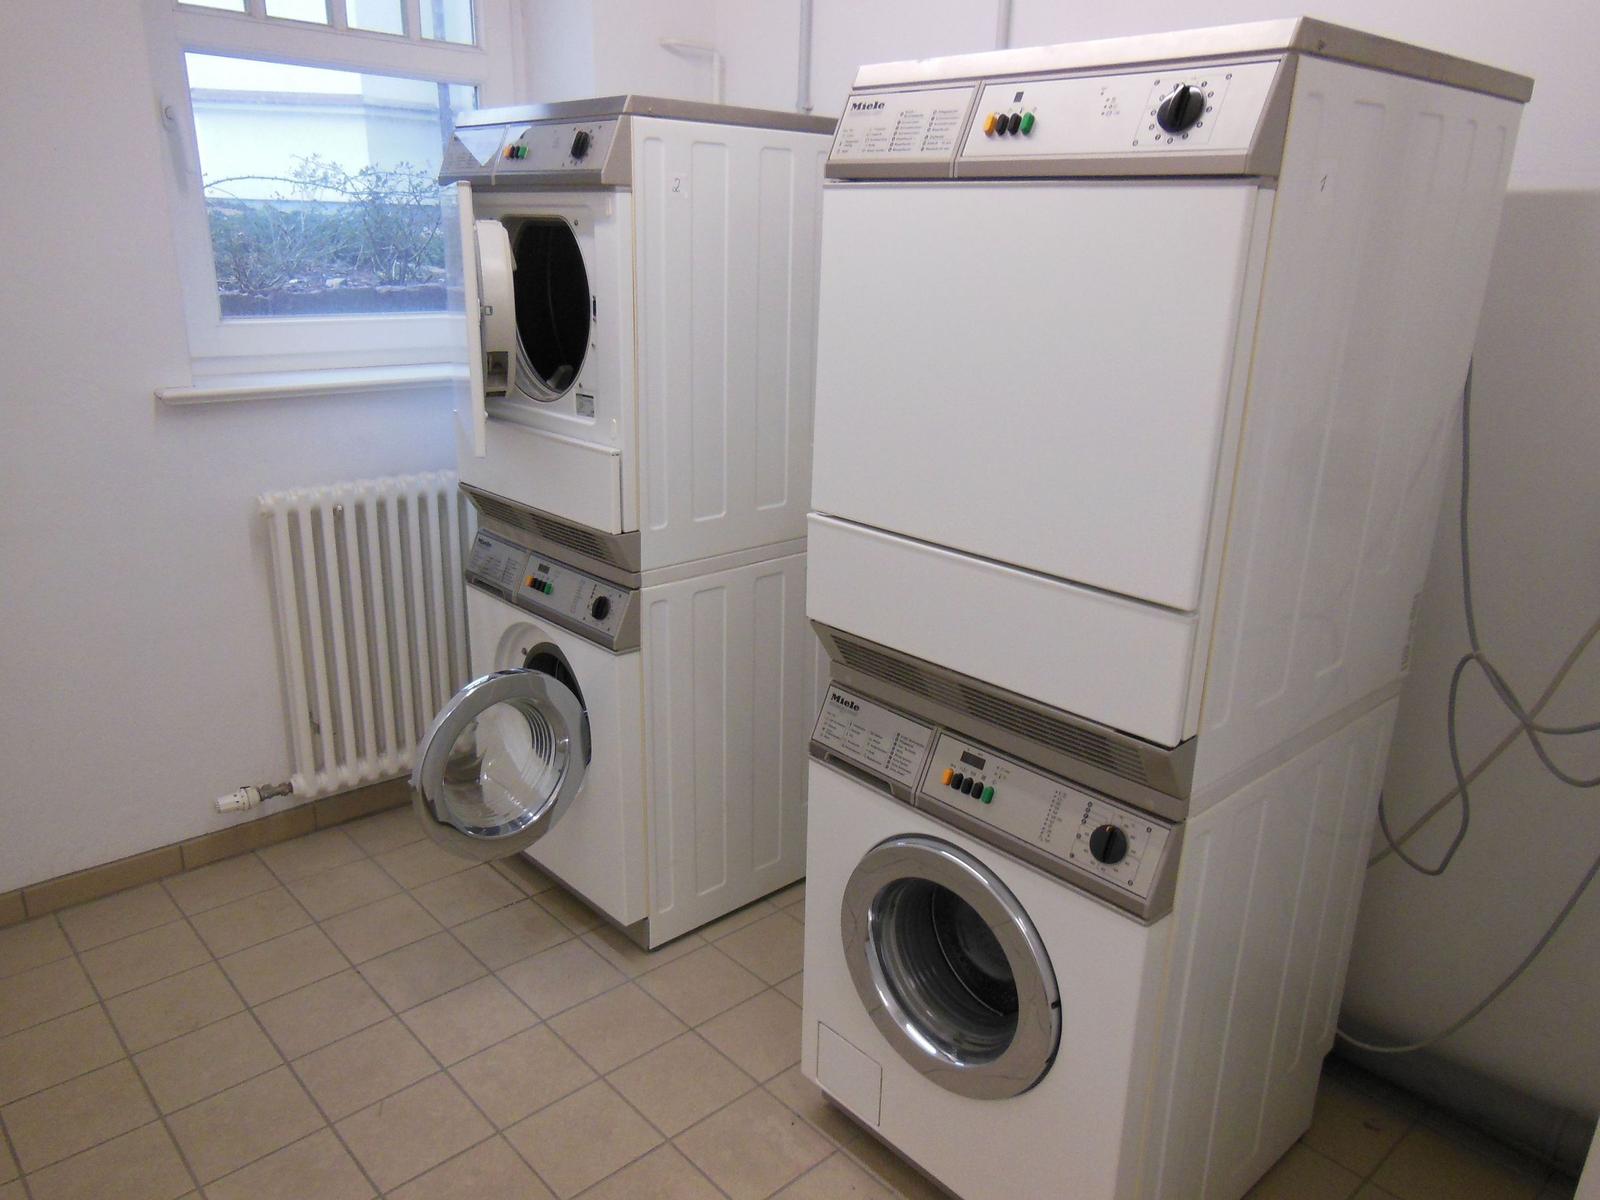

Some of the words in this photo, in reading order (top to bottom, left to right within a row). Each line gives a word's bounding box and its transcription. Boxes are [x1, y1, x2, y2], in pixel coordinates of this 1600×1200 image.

[851, 101, 885, 111] Miele
[672, 177, 681, 193] 2
[831, 693, 860, 711] Miele
